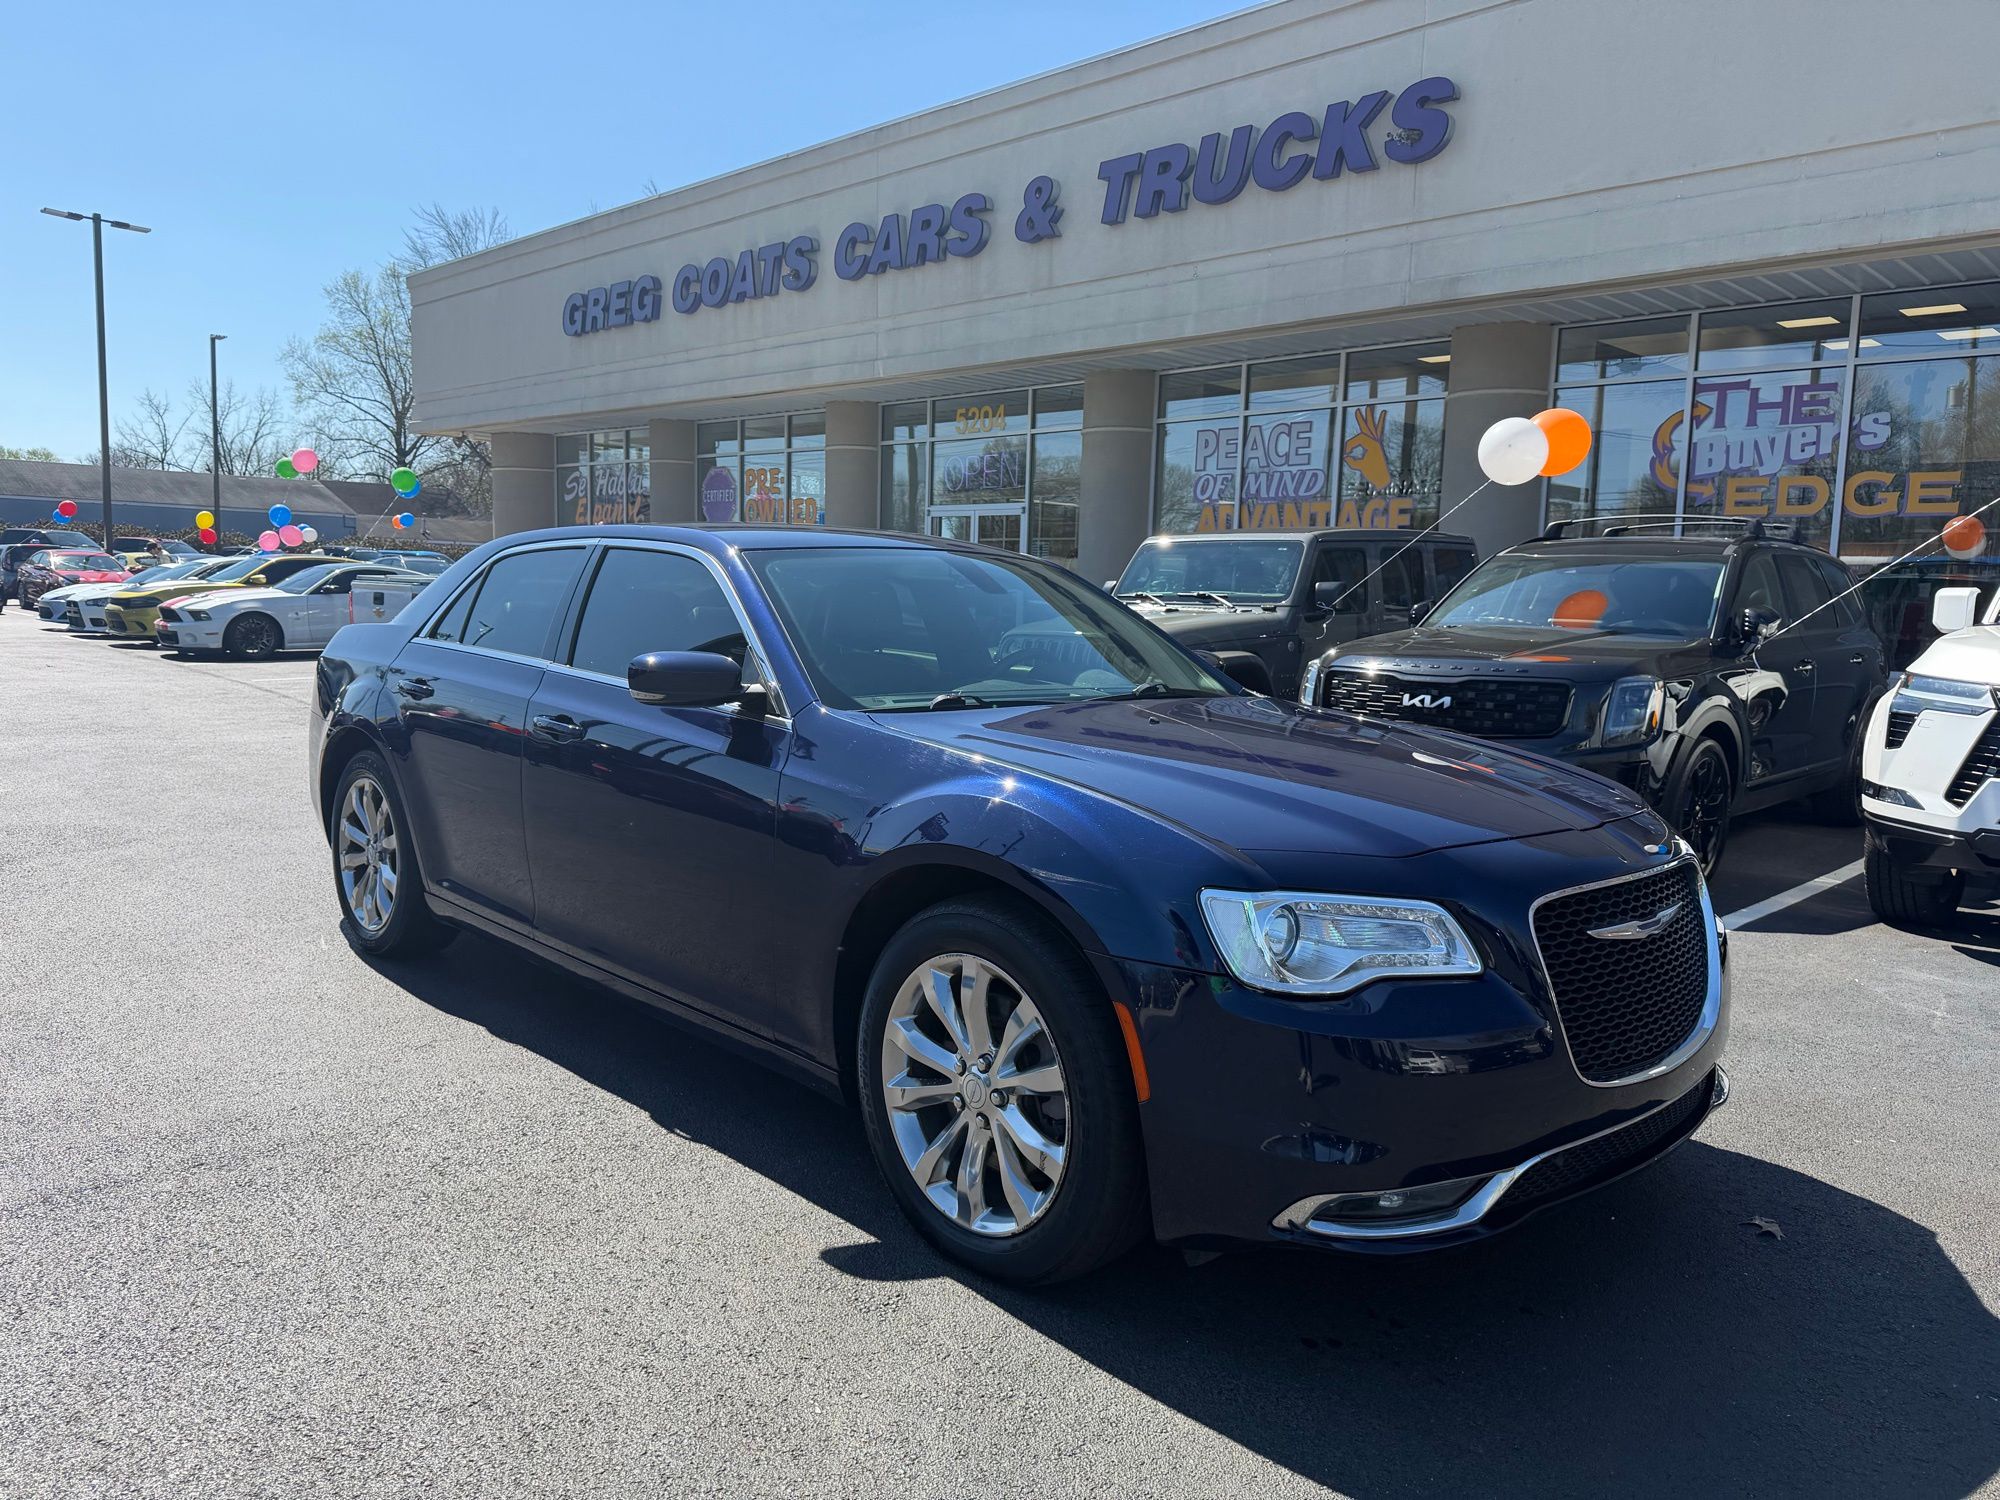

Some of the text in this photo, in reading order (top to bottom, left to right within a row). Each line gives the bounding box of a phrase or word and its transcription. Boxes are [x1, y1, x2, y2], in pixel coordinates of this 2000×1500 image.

[563, 76, 1461, 337] GREG COATS CARS & TRUCKS
[955, 404, 1006, 434] 5204
[1696, 379, 1839, 430] THE
[1195, 421, 1313, 472] PEACE
[1692, 410, 1892, 480] Buyer's
[564, 471, 588, 501] Se
[745, 468, 785, 495] PRE-
[944, 450, 1019, 491] OPEN
[1194, 469, 1326, 500] OF MIND
[703, 489, 735, 502] CERTIFIED
[1720, 470, 1963, 519] EDGE
[1194, 497, 1413, 532] ADVANTAGE
